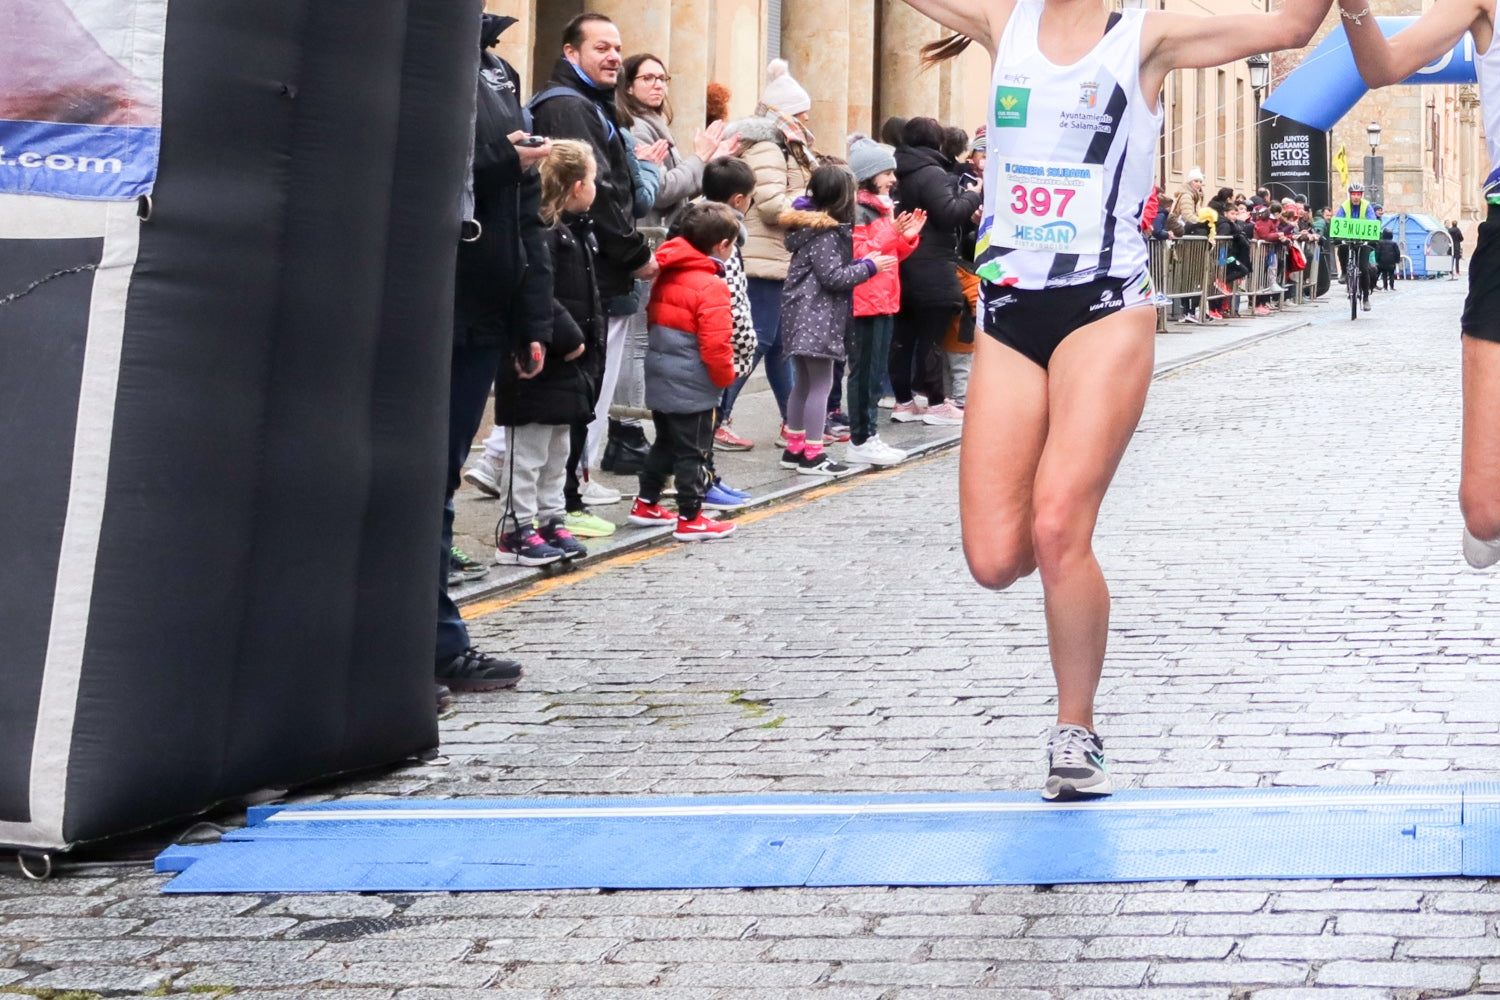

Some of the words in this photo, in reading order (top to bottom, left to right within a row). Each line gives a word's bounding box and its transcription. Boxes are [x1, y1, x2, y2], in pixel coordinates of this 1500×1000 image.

[1060, 111, 1113, 124] Ayuntamiento
[1071, 121, 1112, 133] Salamanca
[1271, 149, 1310, 160] RETOS
[1010, 185, 1076, 218] 397
[1015, 225, 1069, 243] HESAN
[1348, 223, 1378, 237] MUJER
[1090, 299, 1122, 312] VIATOR
